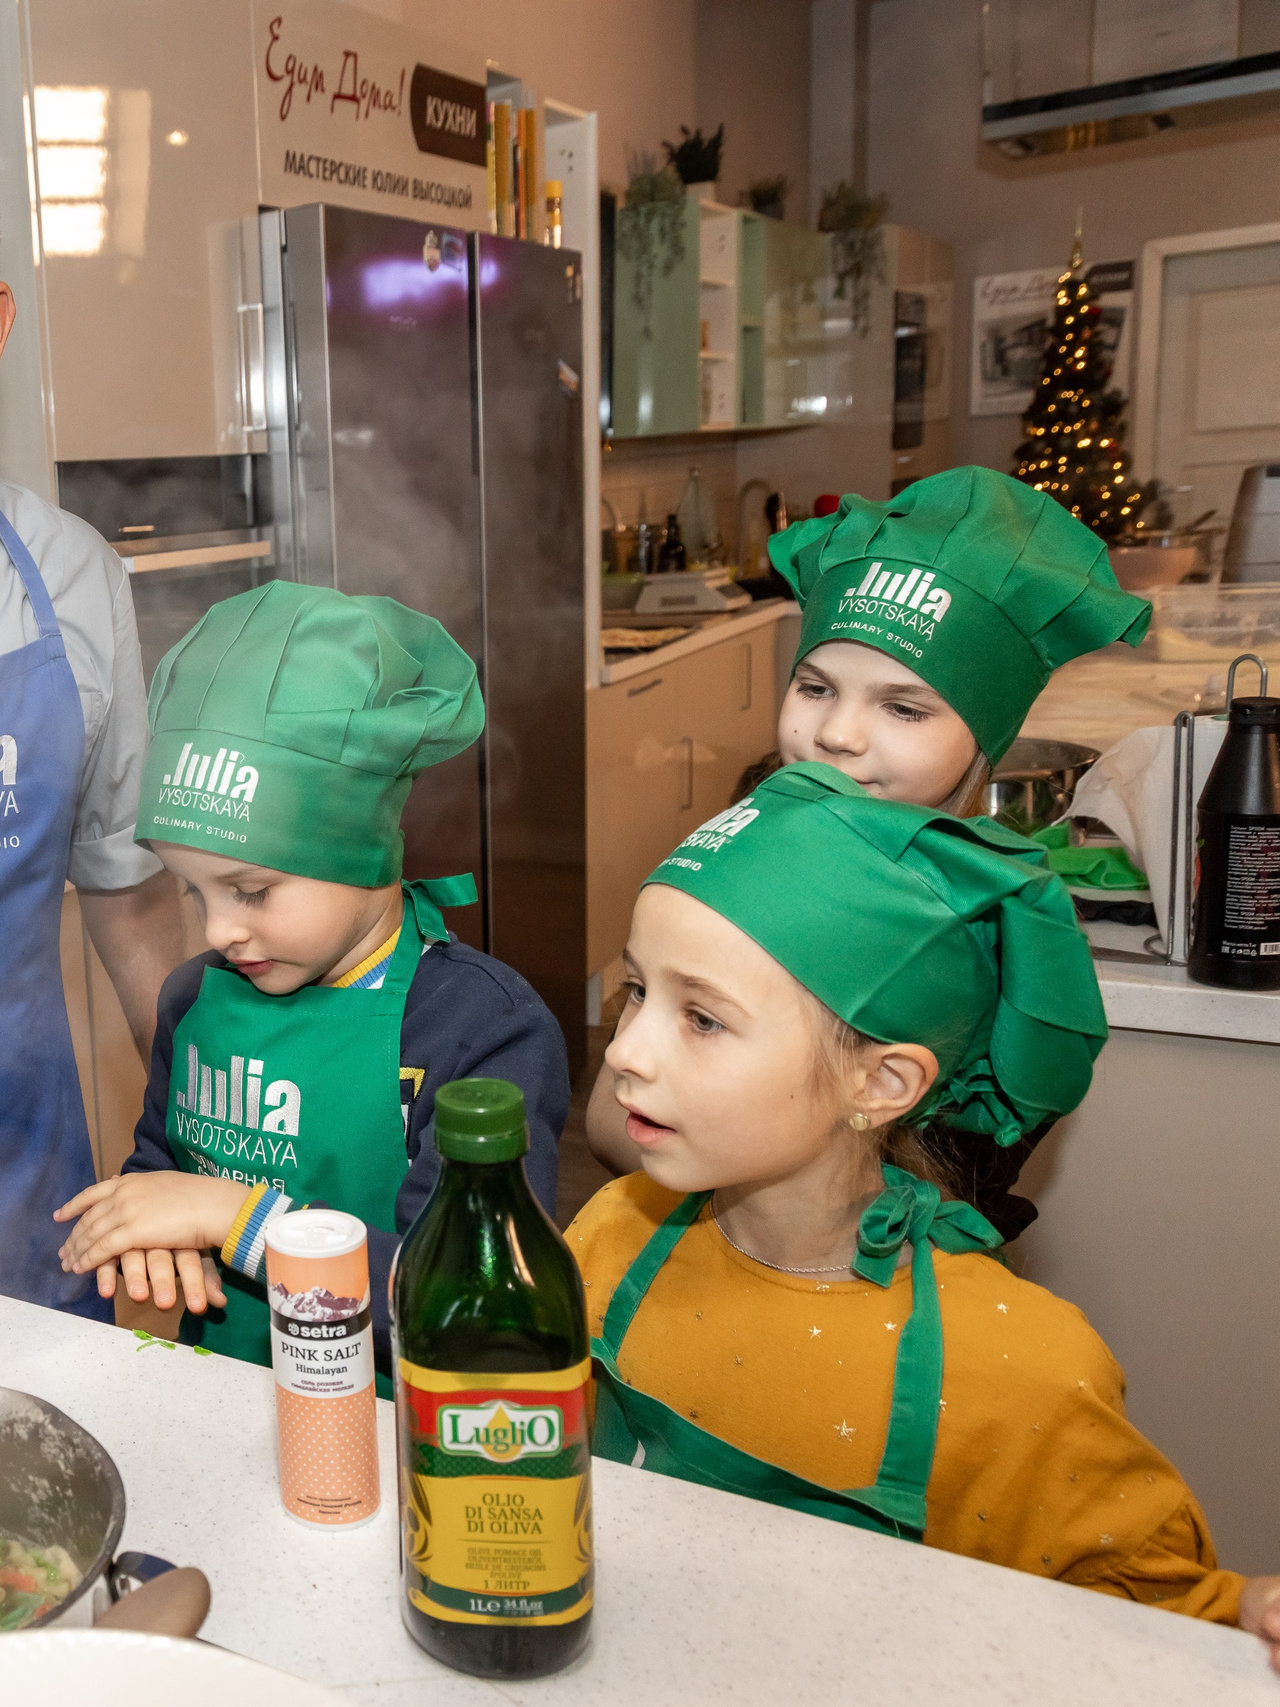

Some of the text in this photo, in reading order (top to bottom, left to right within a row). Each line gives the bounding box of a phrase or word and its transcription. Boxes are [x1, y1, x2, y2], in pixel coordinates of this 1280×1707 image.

[265, 15, 406, 122] Едим Дома!
[425, 95, 478, 138] КУХНИ
[283, 149, 473, 209] МАСТЕРСКИЕ ЮЛИИ ВЫСОЦКОЙ
[843, 561, 952, 623] Julia
[837, 598, 936, 642] VYSOTSKAYA
[830, 620, 923, 658] CULINARY STUDIO
[162, 742, 260, 803] Julia
[157, 787, 251, 823] VYSOTSKAYA
[153, 815, 248, 844] CULINARY STUDIO
[669, 857, 702, 871] STUDIO
[175, 1042, 302, 1138] Julia
[174, 1110, 299, 1169] VYSOTSKAYA
[300, 1324, 348, 1338] setra
[281, 1341, 361, 1362] PINK SALT
[295, 1363, 348, 1377] Himalayan
[464, 1506, 544, 1521] DI SANSA
[481, 1492, 525, 1507] OLIO
[467, 1520, 543, 1535] DI OLIVA
[494, 1580, 531, 1591] ЛИТР
